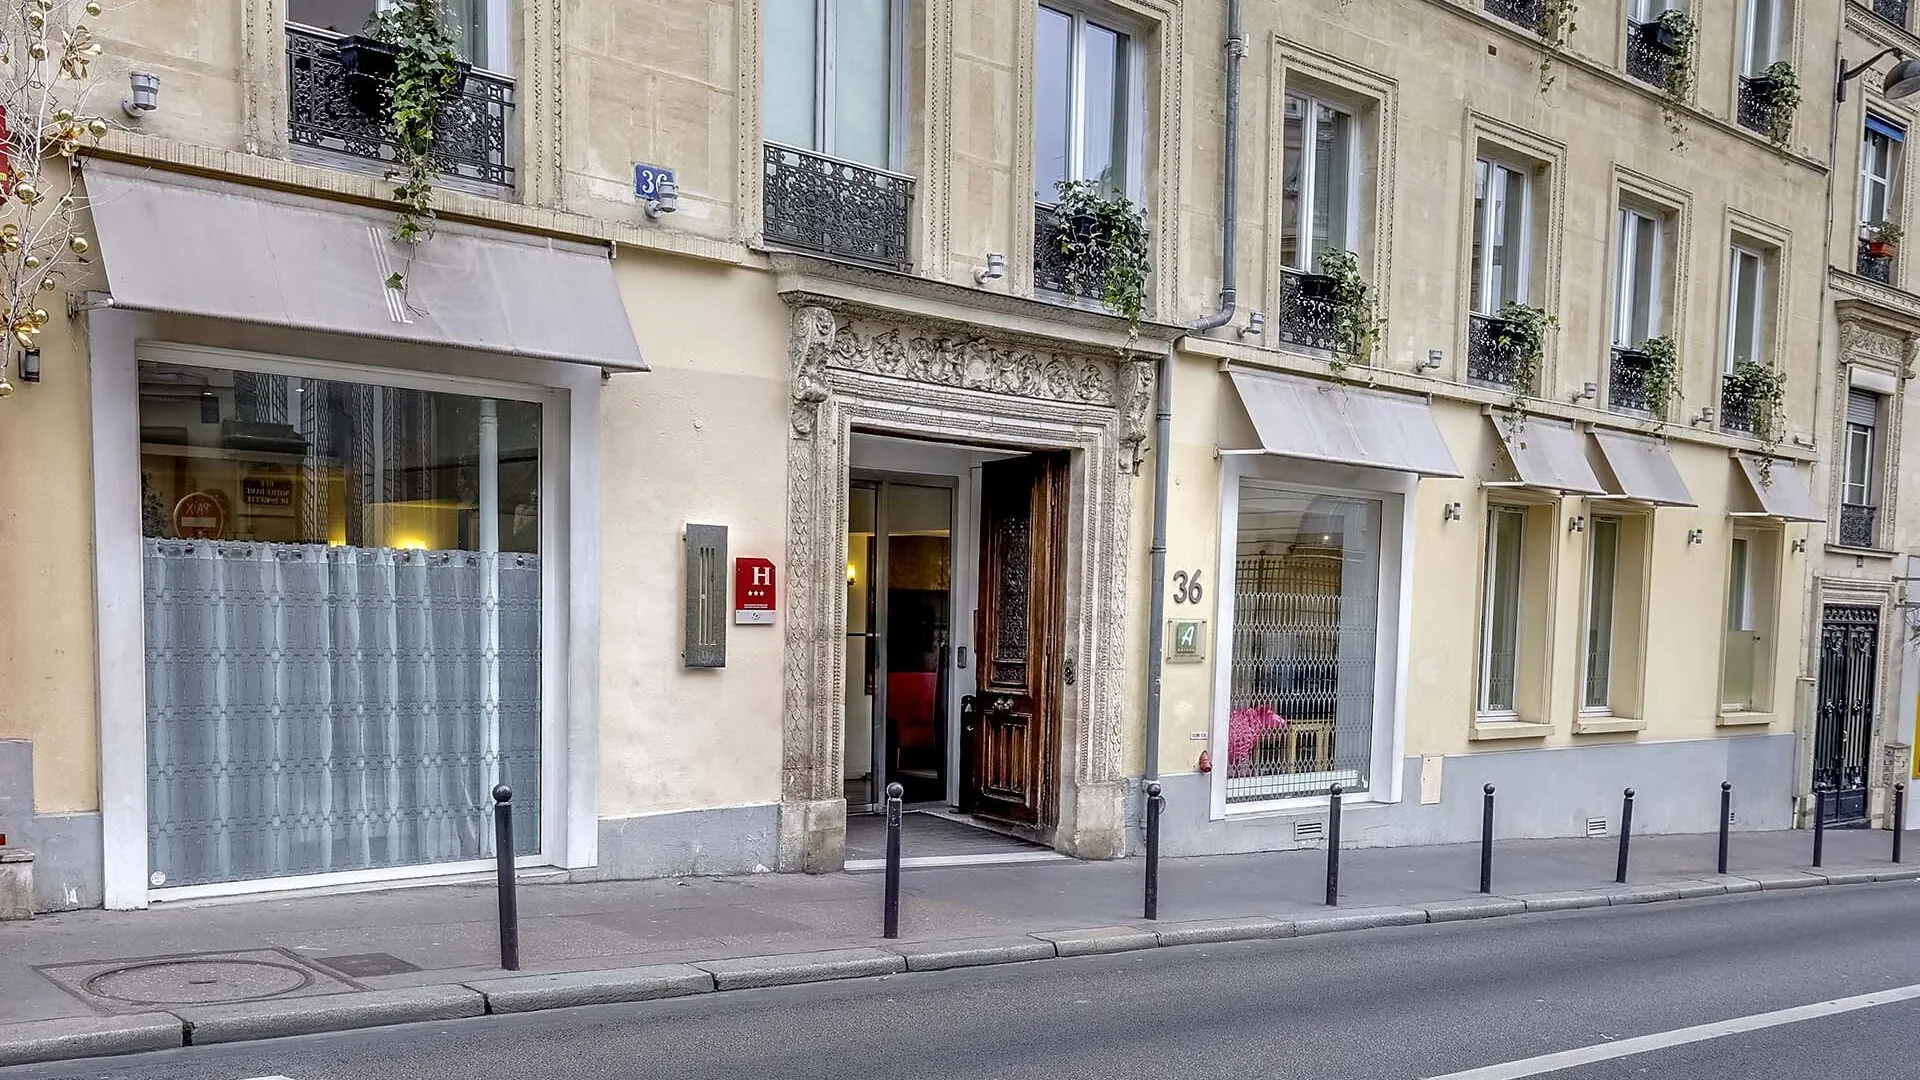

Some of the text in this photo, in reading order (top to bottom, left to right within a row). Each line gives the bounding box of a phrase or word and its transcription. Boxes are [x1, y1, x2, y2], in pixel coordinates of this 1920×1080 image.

[752, 566, 772, 586] H
[1173, 569, 1203, 605] 36
[1181, 625, 1195, 646] A
